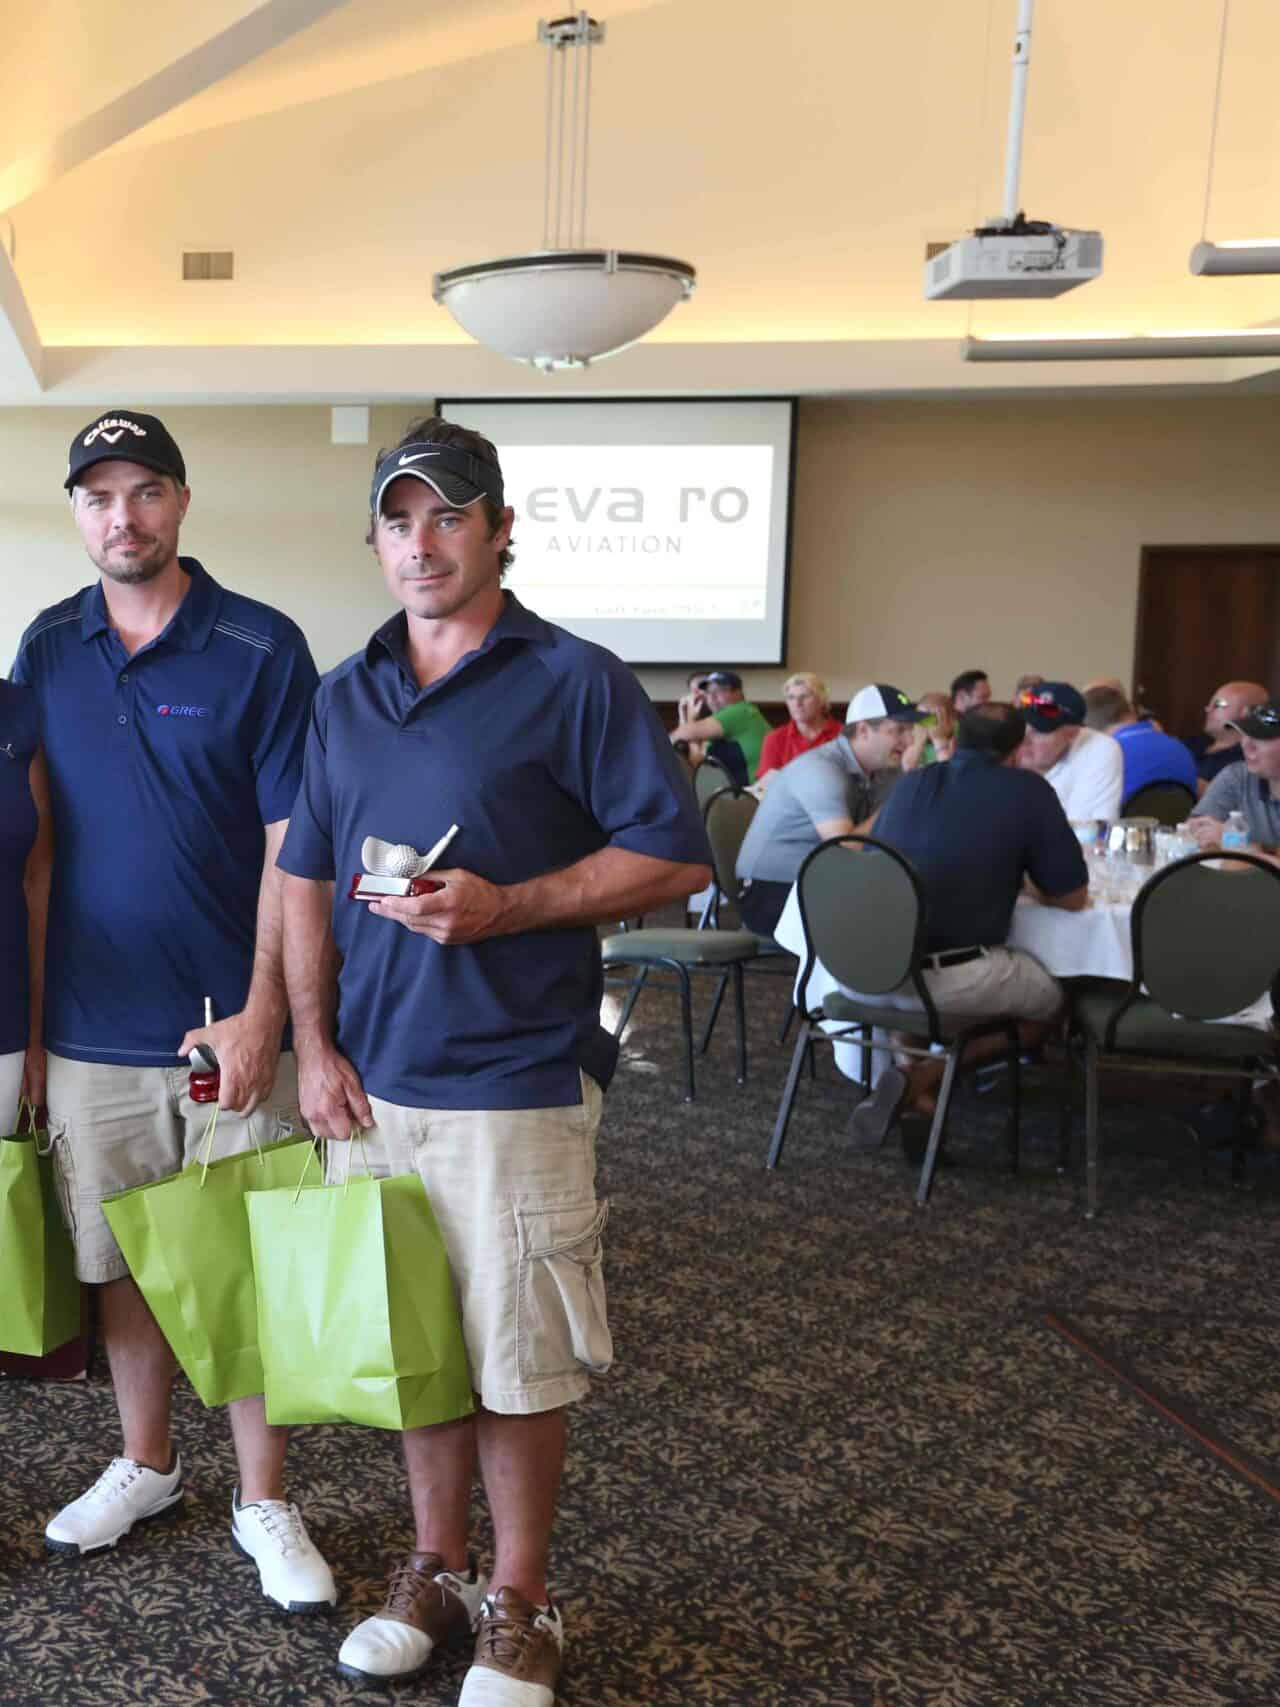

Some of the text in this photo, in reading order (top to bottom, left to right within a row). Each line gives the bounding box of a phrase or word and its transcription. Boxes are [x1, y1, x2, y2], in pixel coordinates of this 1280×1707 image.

[515, 487, 645, 523] eva
[545, 535, 684, 554] AVIATION
[169, 704, 209, 718] GREE
